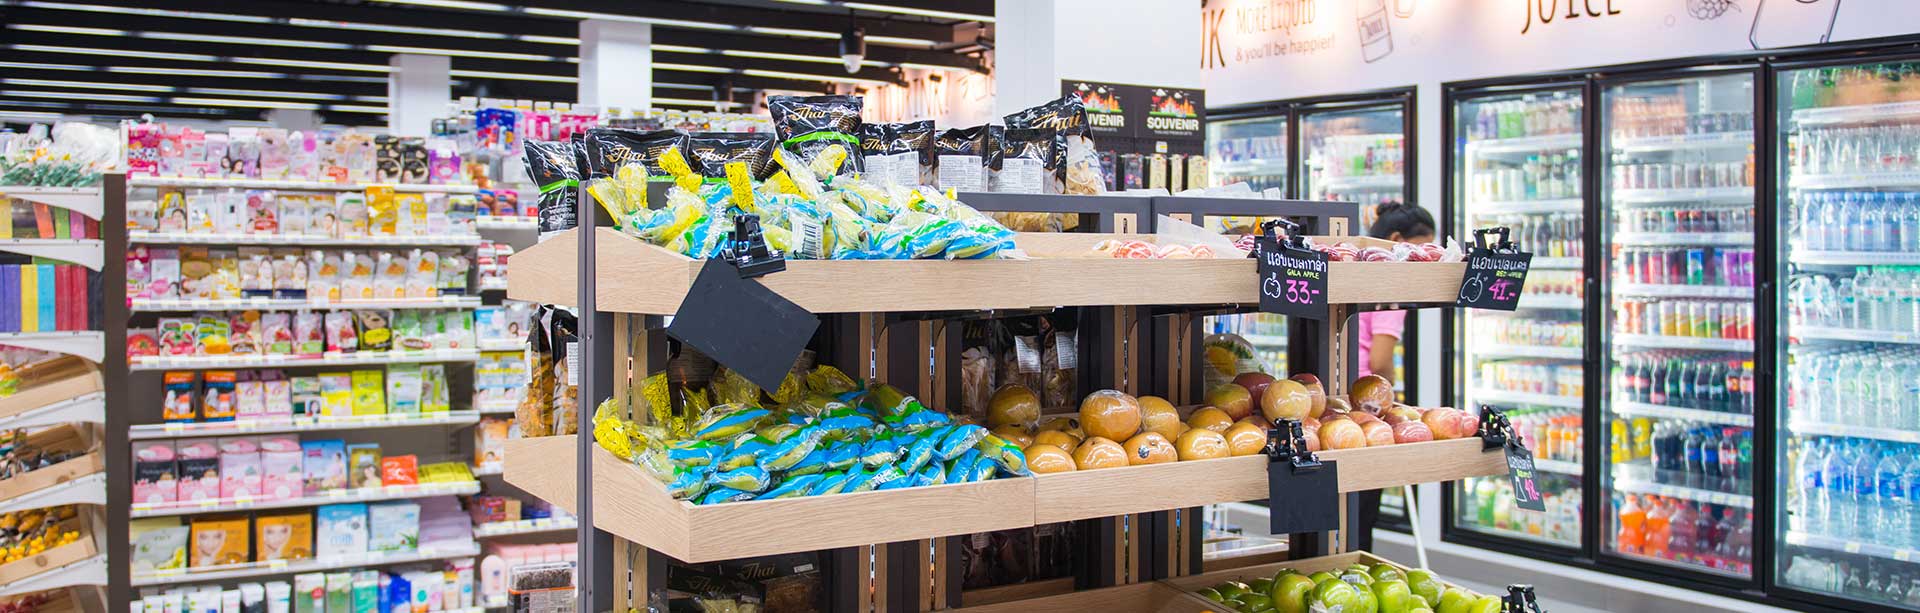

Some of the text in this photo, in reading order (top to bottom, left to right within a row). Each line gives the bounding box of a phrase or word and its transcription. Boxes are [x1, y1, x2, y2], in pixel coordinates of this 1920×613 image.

[1146, 116, 1200, 132] SOUVENIR
[1286, 268, 1320, 280] GALA APPLE
